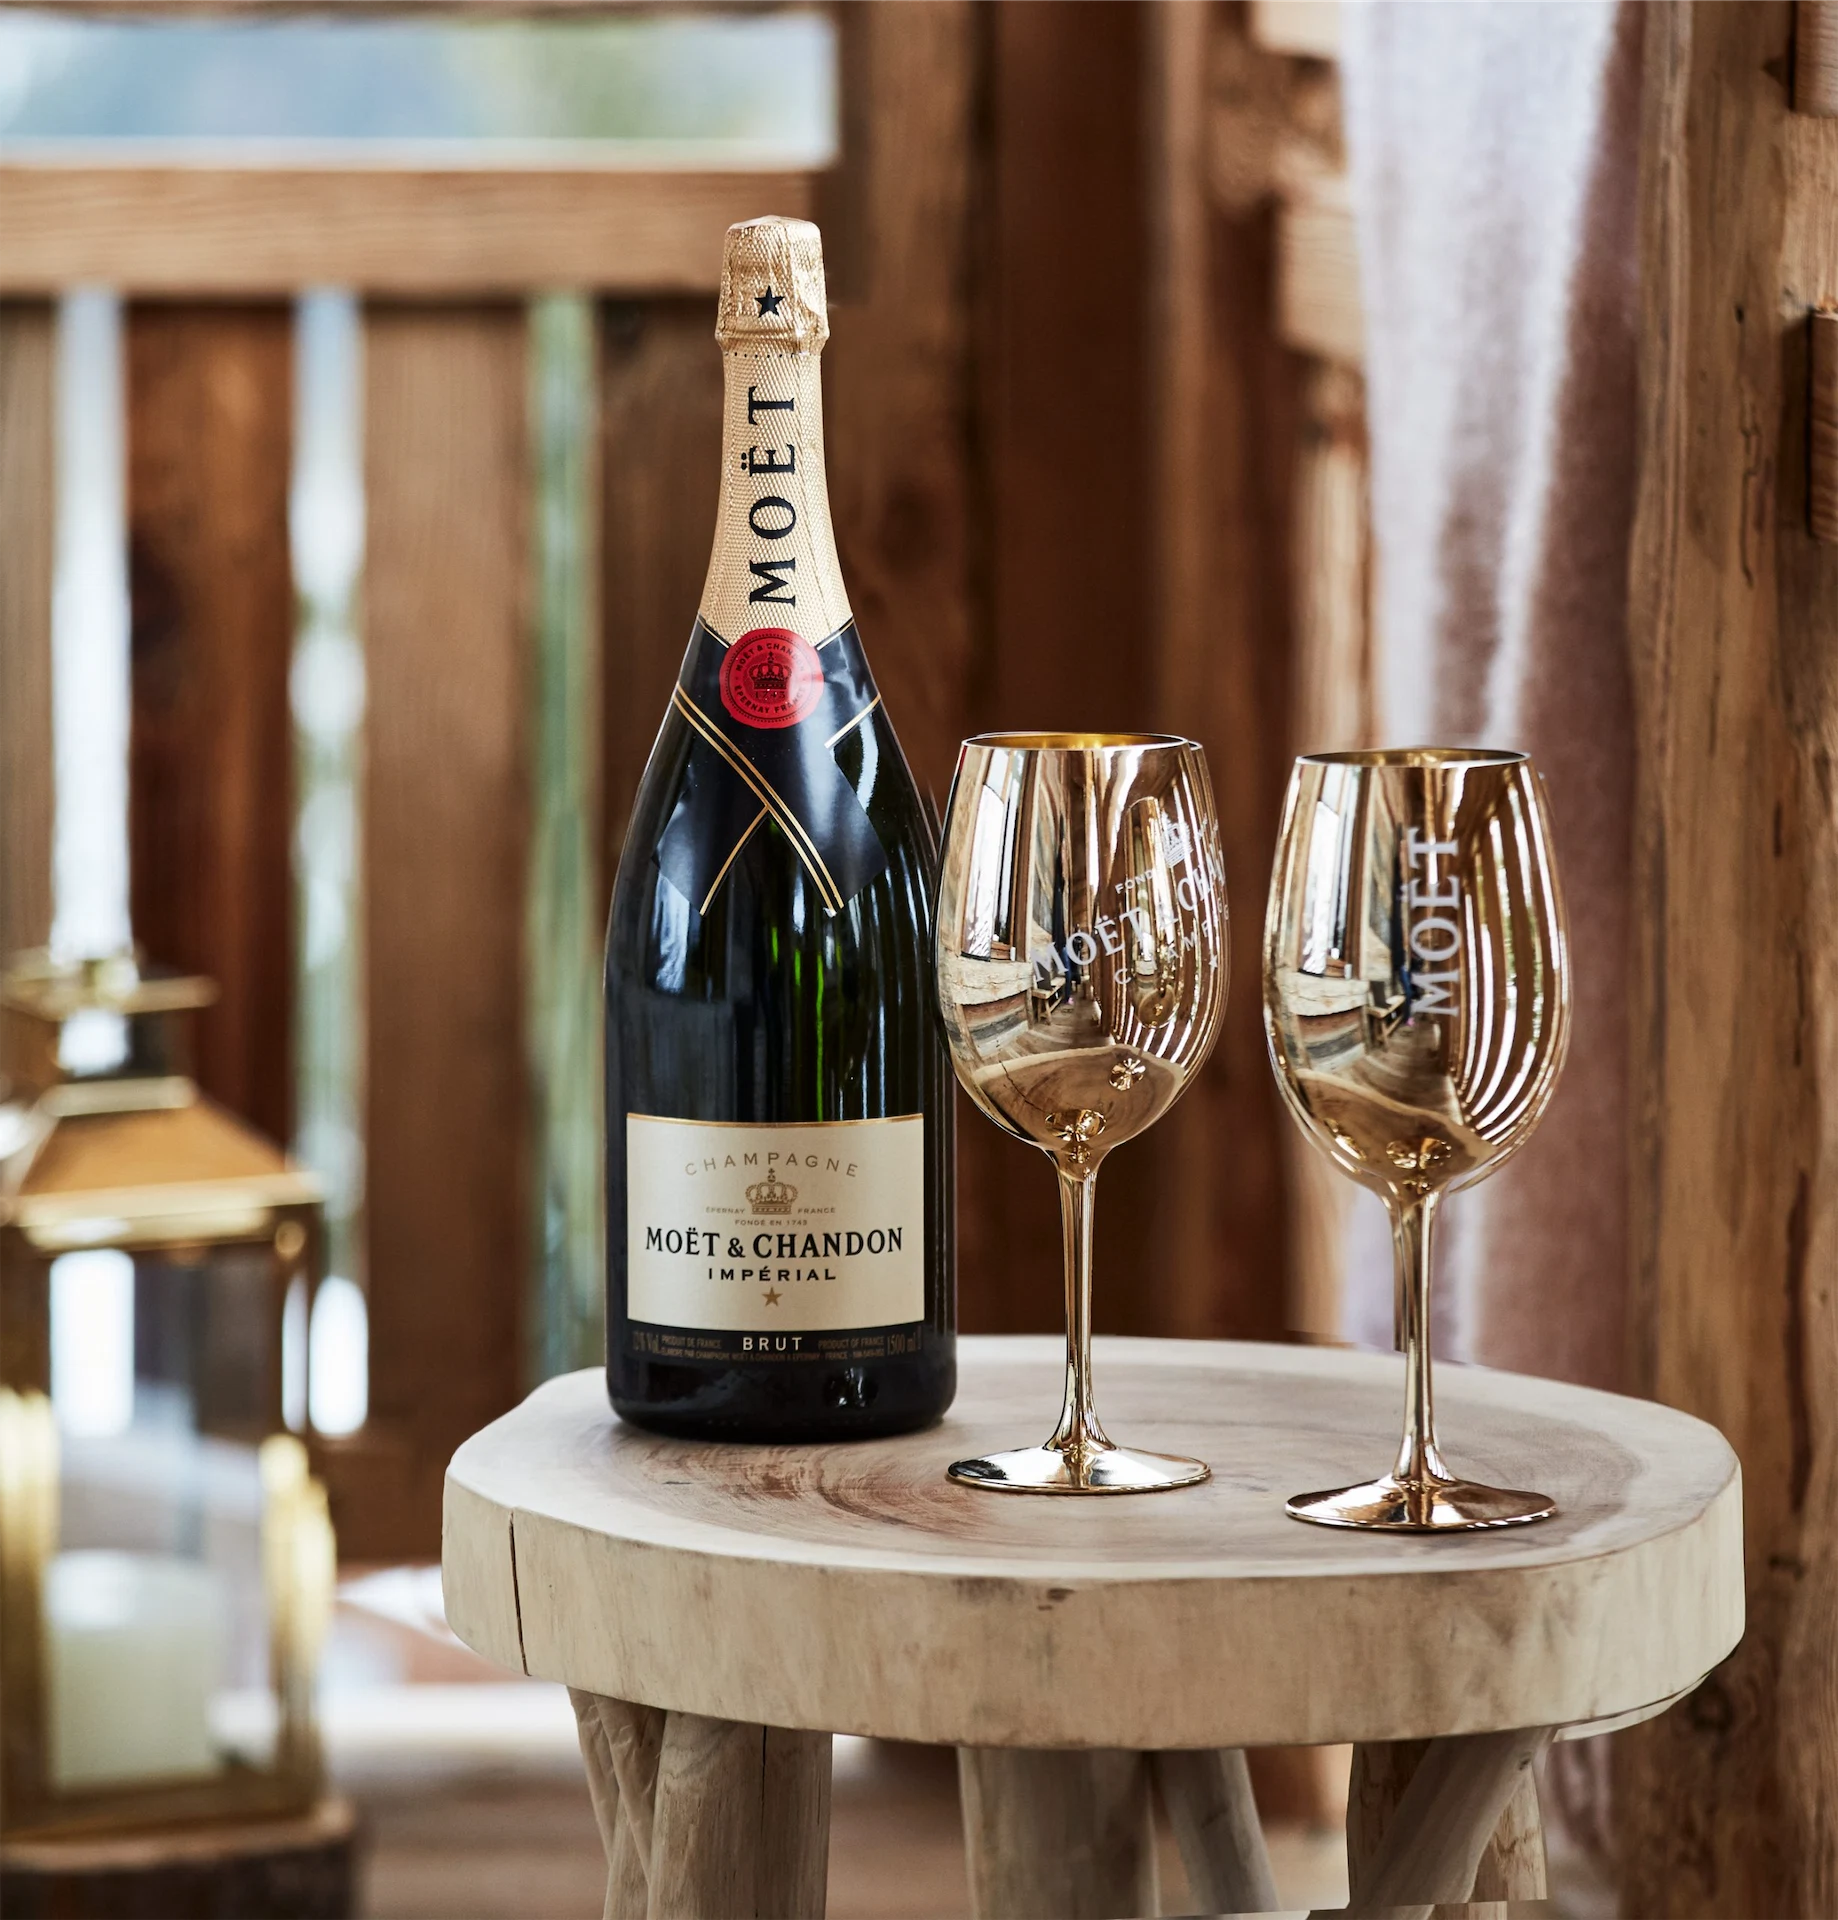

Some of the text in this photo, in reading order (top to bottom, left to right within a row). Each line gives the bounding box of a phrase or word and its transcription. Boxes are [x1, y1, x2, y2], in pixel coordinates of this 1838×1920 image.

[741, 385, 796, 609] MOËT
[755, 690, 786, 699] 1743
[1397, 826, 1460, 1017] MOËT
[1030, 906, 1149, 983] MOËT
[685, 1152, 858, 1178] CHAMPAGNE
[646, 1227, 903, 1259] MOËT & CHANDON
[708, 1266, 837, 1282] IMPÉRIAL
[743, 1337, 802, 1351] BRUT
[861, 1336, 885, 1347] FRANCE
